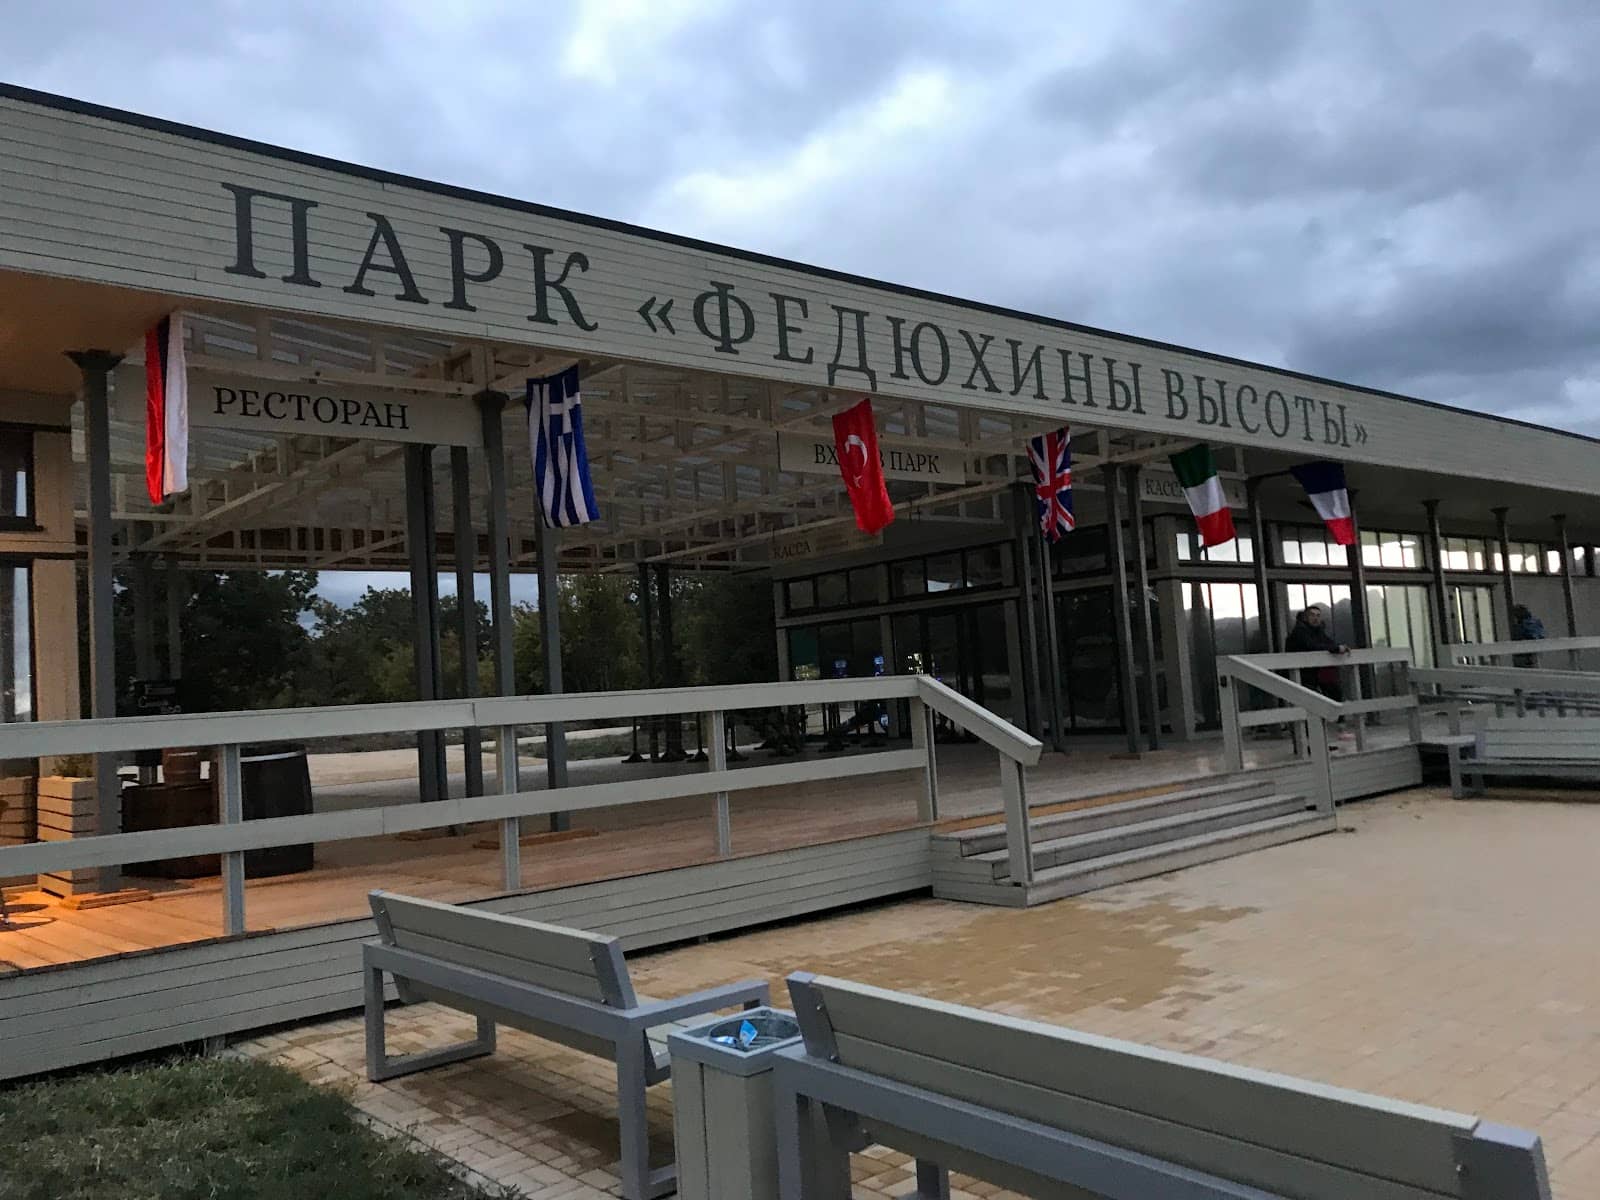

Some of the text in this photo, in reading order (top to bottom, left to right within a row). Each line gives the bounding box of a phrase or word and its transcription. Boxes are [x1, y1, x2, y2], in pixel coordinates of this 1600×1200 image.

[221, 182, 1368, 447] ПАРК «ФЕДЮХИНЫ ВЫСОТЫ»
[213, 386, 410, 430] РЕСТОРАН
[813, 443, 841, 466] ВХ
[889, 451, 941, 474] ПАРК
[1144, 479, 1184, 498] КАСС
